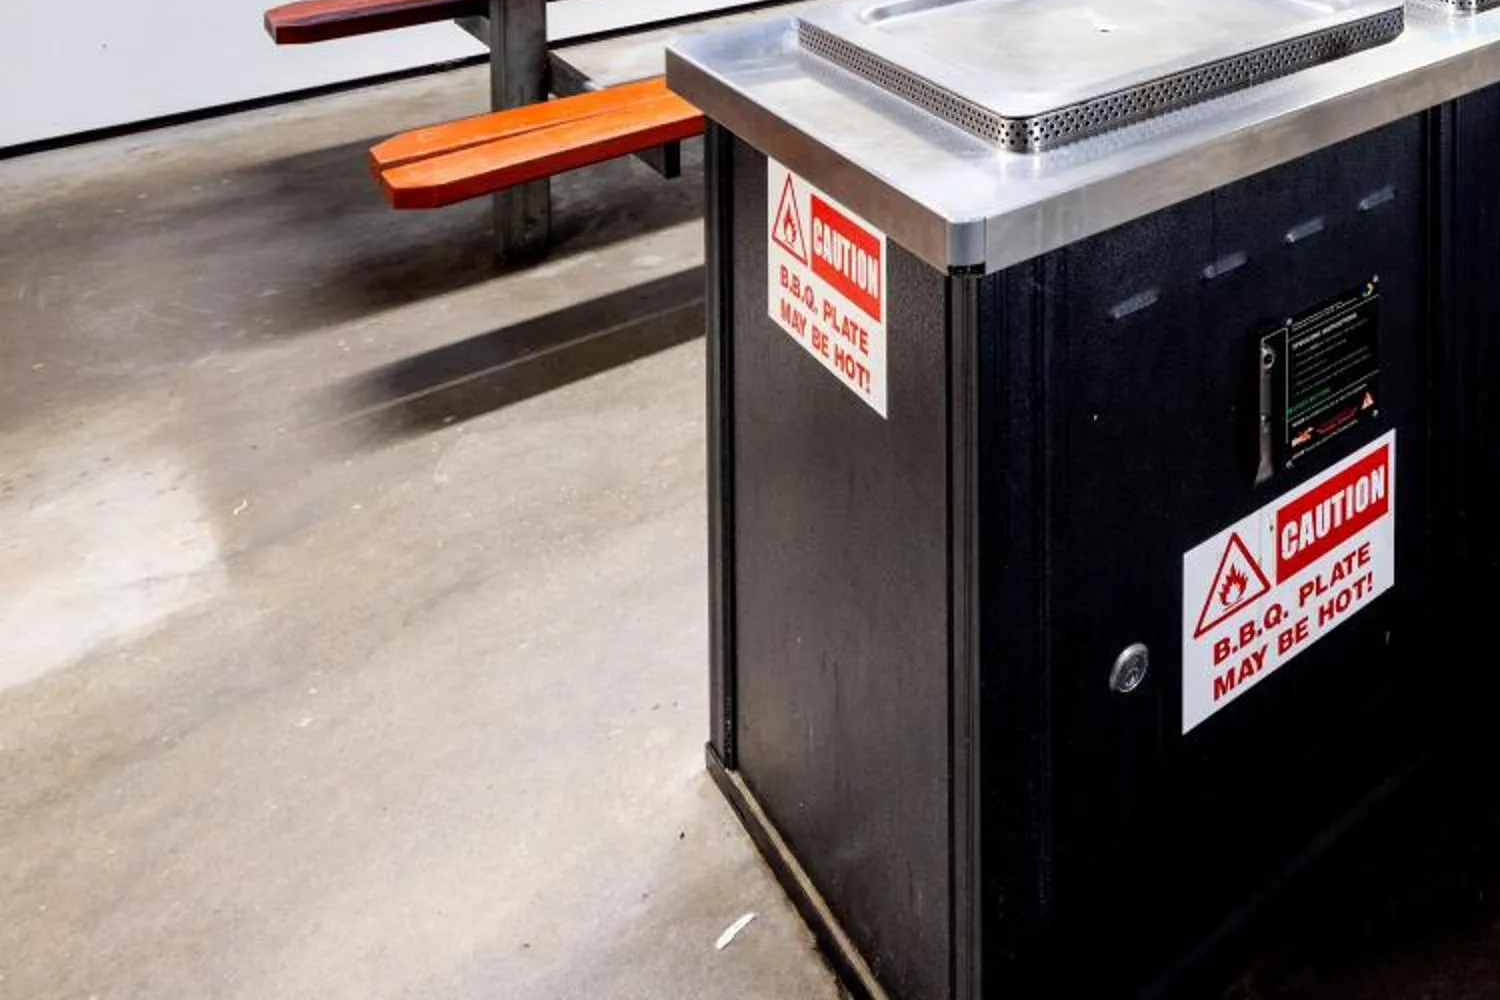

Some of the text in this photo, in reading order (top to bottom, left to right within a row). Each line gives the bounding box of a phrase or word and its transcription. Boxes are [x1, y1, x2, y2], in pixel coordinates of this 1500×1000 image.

[813, 217, 879, 298] CAUTION
[779, 264, 869, 356] B.B.Q. PLATE
[780, 297, 871, 393] MAY BE HOT!
[1281, 464, 1385, 560] CAUTION
[1213, 541, 1372, 666] B.B.Q. PLATE
[1213, 572, 1374, 702] MAY BE HOT!
